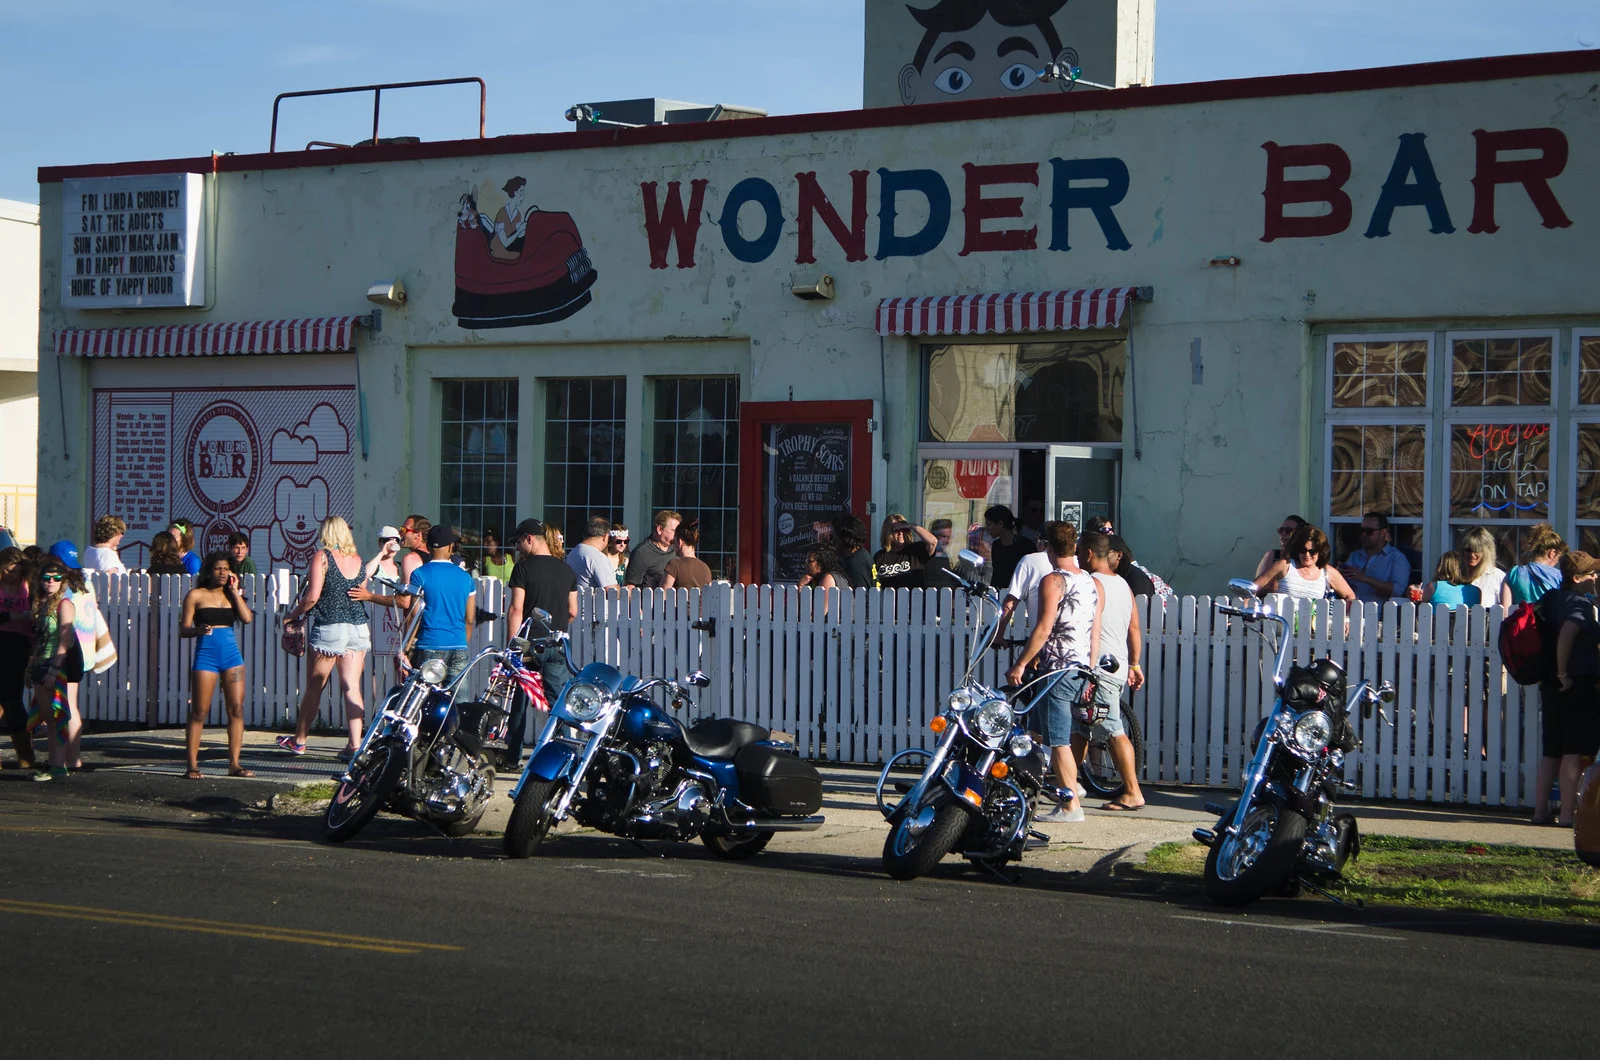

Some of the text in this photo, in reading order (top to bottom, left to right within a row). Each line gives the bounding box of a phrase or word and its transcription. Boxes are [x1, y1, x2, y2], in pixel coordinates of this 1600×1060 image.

[82, 190, 180, 211] FRI LINDA CHORNEY
[641, 127, 1574, 270] WONDER BAR
[82, 213, 164, 232] SAT THE ADICTS
[74, 233, 178, 254] SUN SANDY MACK JAM
[95, 256, 124, 274] HAPPY
[130, 255, 175, 272] MONDAYS
[71, 276, 173, 296] HOME OF YAPPY HOUR
[199, 440, 247, 453] WONDER
[779, 435, 819, 457] TROPHY
[816, 444, 845, 471] SCARS
[198, 453, 247, 478] BAR
[793, 474, 813, 482] BALANCE
[815, 474, 836, 483] BETWEEN
[1480, 482, 1546, 499] ON TAP
[209, 535, 230, 544] YAPP
[209, 544, 230, 552] HOU
